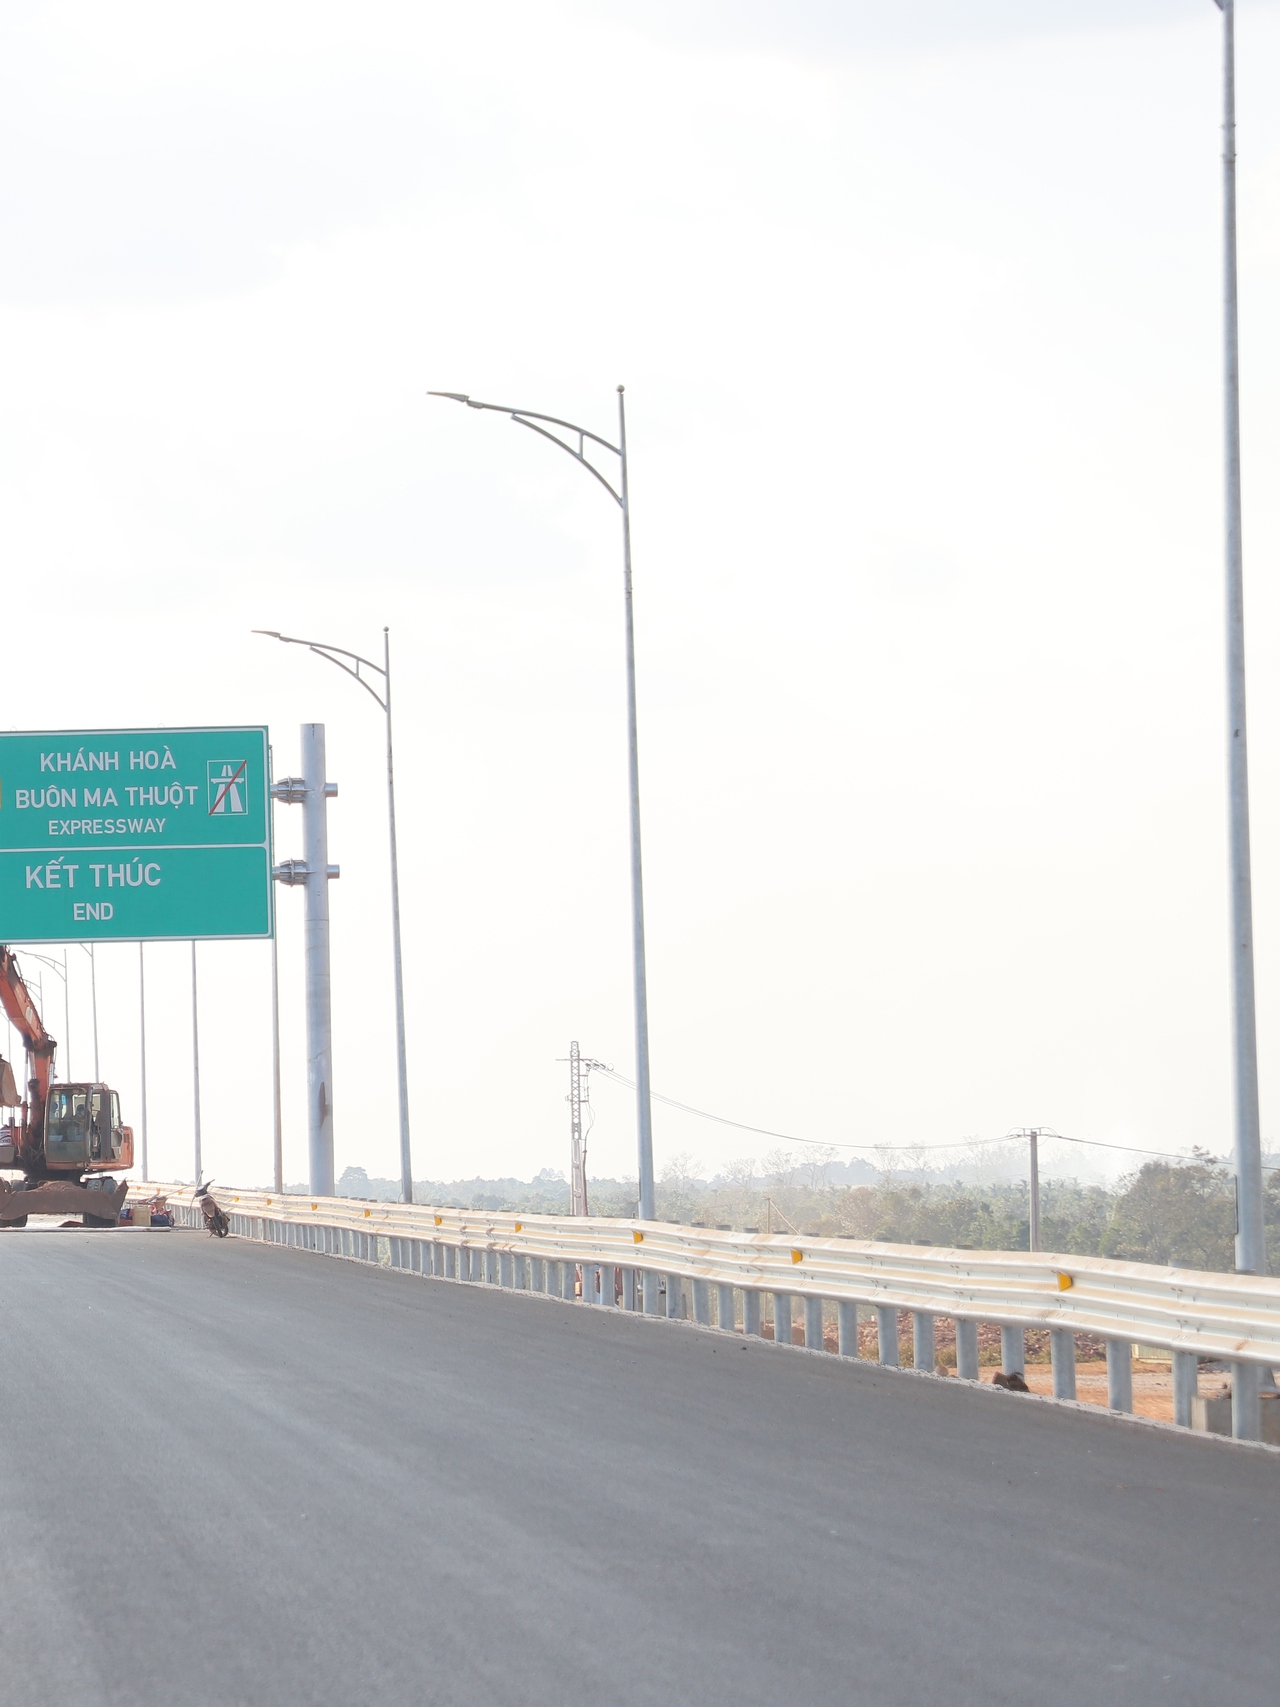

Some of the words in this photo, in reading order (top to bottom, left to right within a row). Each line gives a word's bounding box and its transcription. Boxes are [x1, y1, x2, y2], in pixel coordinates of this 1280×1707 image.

[40, 747, 120, 772] KHÁNH
[130, 745, 177, 770] HOÀ
[16, 784, 77, 809] BUÔN
[83, 788, 119, 807] MA
[125, 782, 199, 810] THUỘT
[49, 818, 167, 836] EXPRESSWAY
[26, 856, 80, 889] KẾT
[89, 856, 162, 888] THÚC
[73, 903, 114, 921] END
